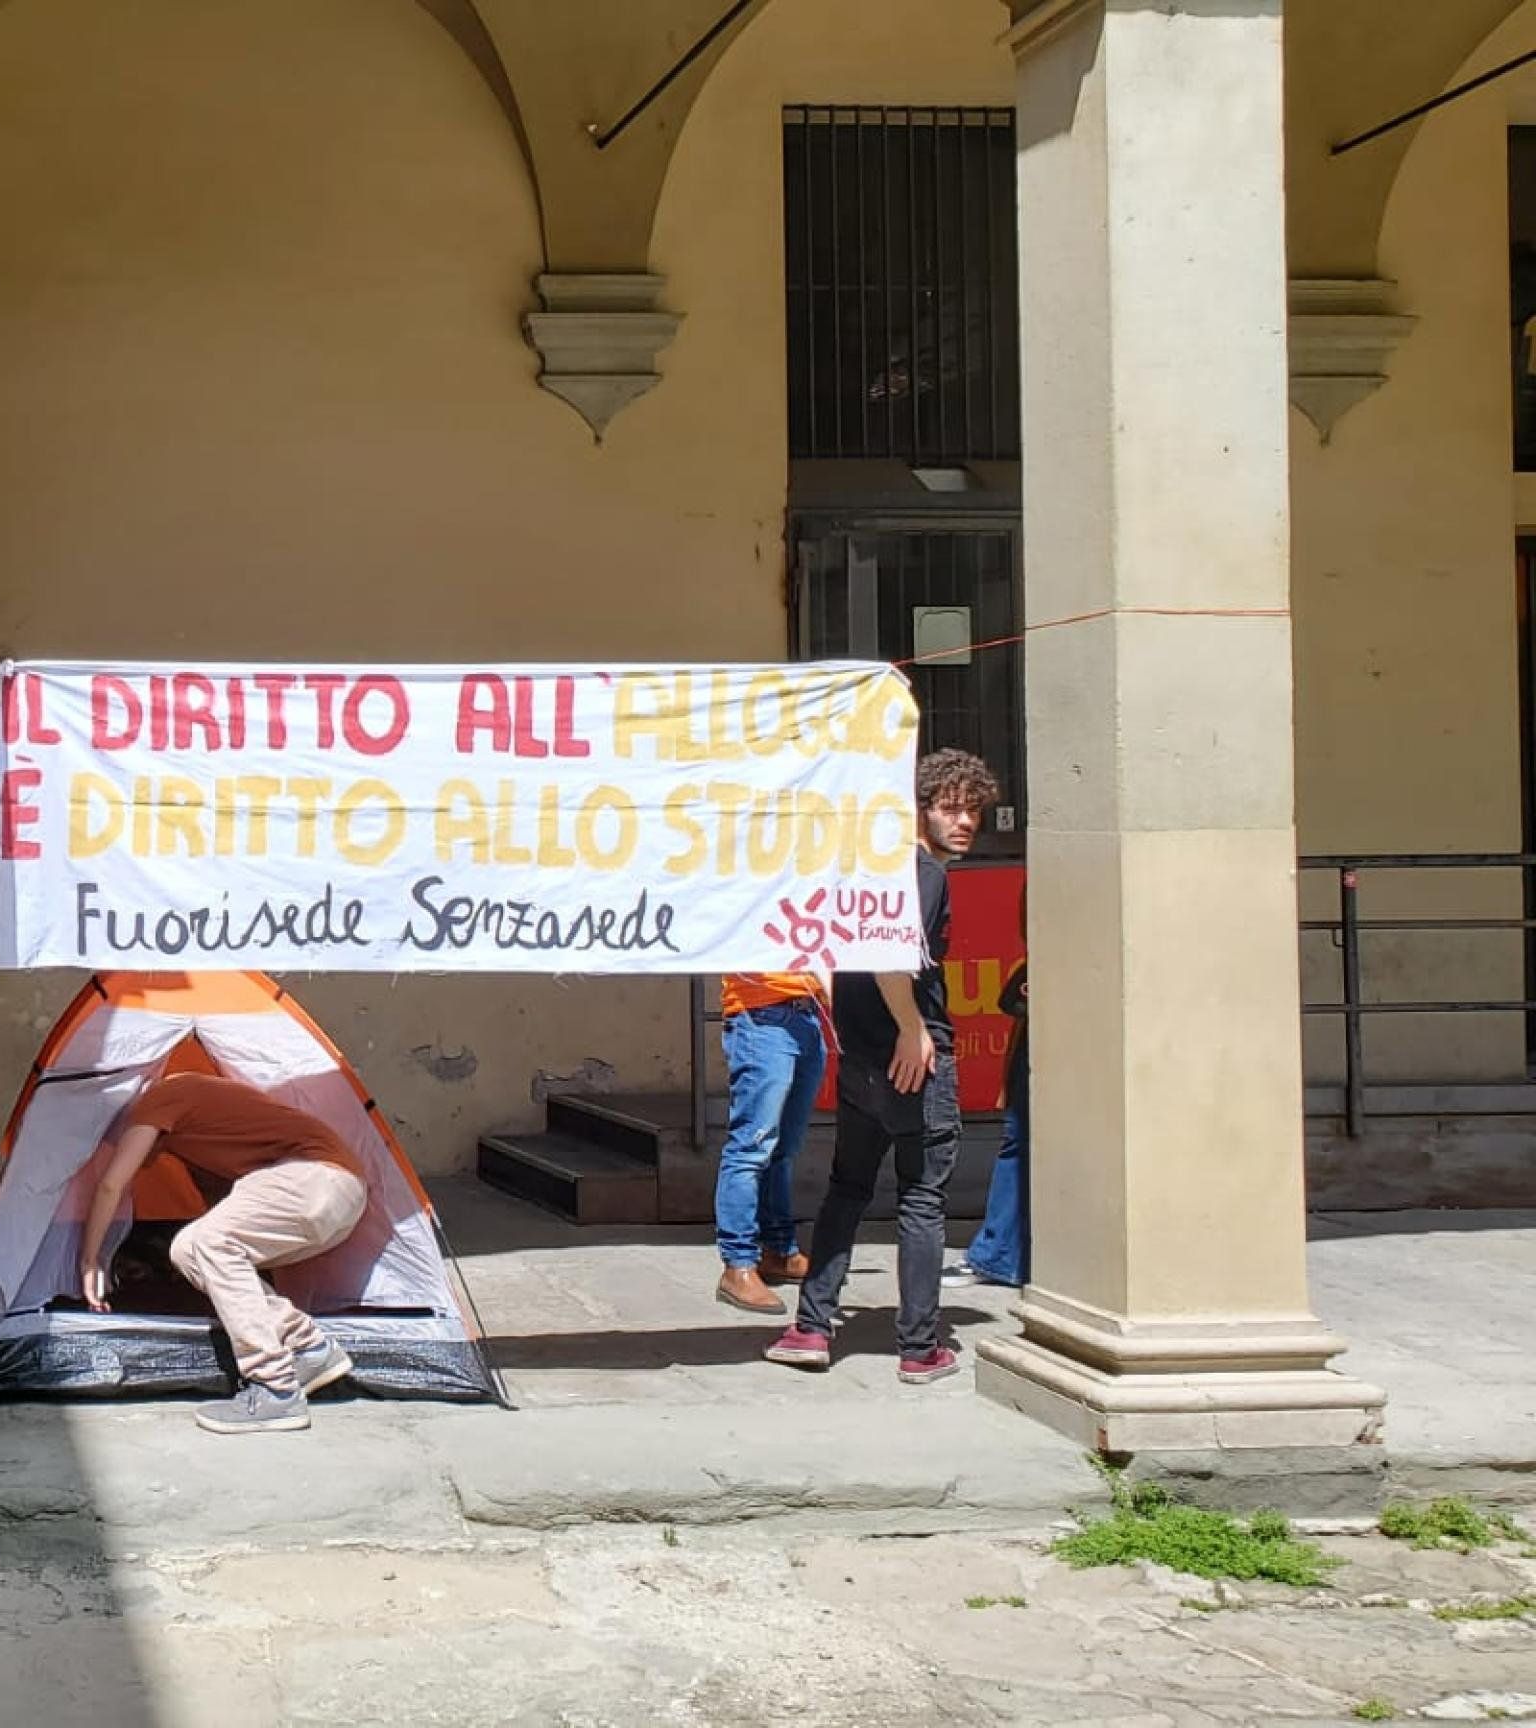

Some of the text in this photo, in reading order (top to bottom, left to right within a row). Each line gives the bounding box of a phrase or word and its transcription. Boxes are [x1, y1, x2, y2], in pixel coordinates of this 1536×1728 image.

[1, 672, 61, 745] IL
[91, 672, 410, 755] DIRITTO
[0, 754, 914, 878] È DIRITTO ALLO STUDIO
[76, 875, 681, 956] Fuorisede Senzasede
[836, 887, 905, 920] UDU
